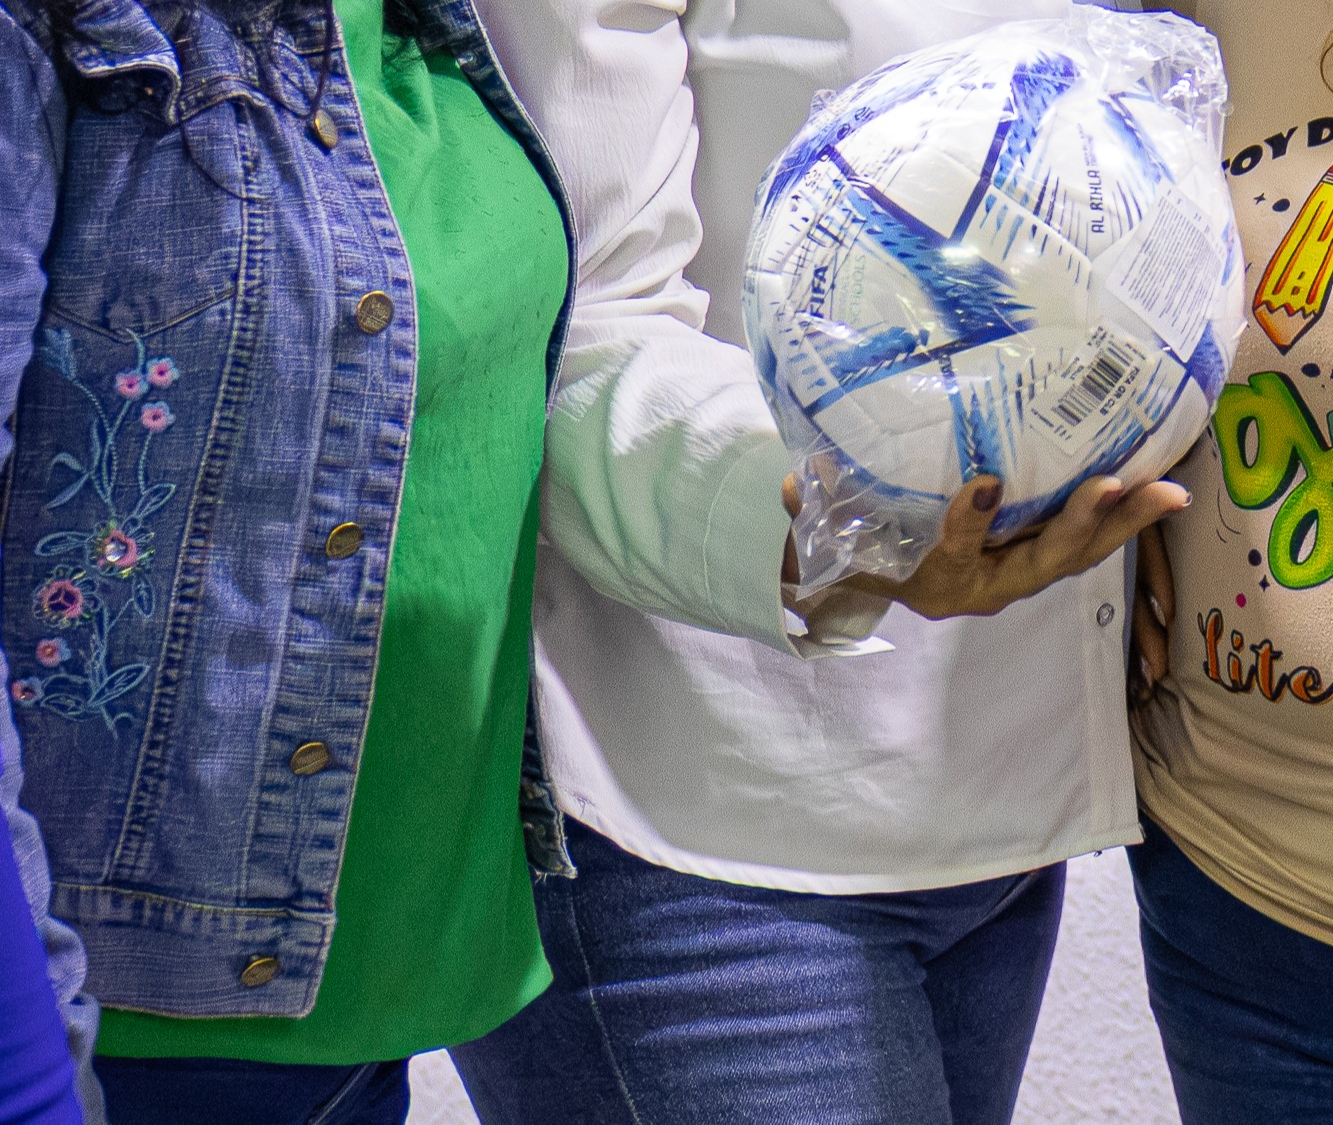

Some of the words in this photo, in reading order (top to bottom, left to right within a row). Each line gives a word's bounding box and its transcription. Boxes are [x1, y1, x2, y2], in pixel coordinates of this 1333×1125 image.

[1221, 126, 1298, 176] OY
[1087, 170, 1105, 211] RIHLA
[1091, 215, 1105, 233] AL
[810, 265, 829, 318] FIFA
